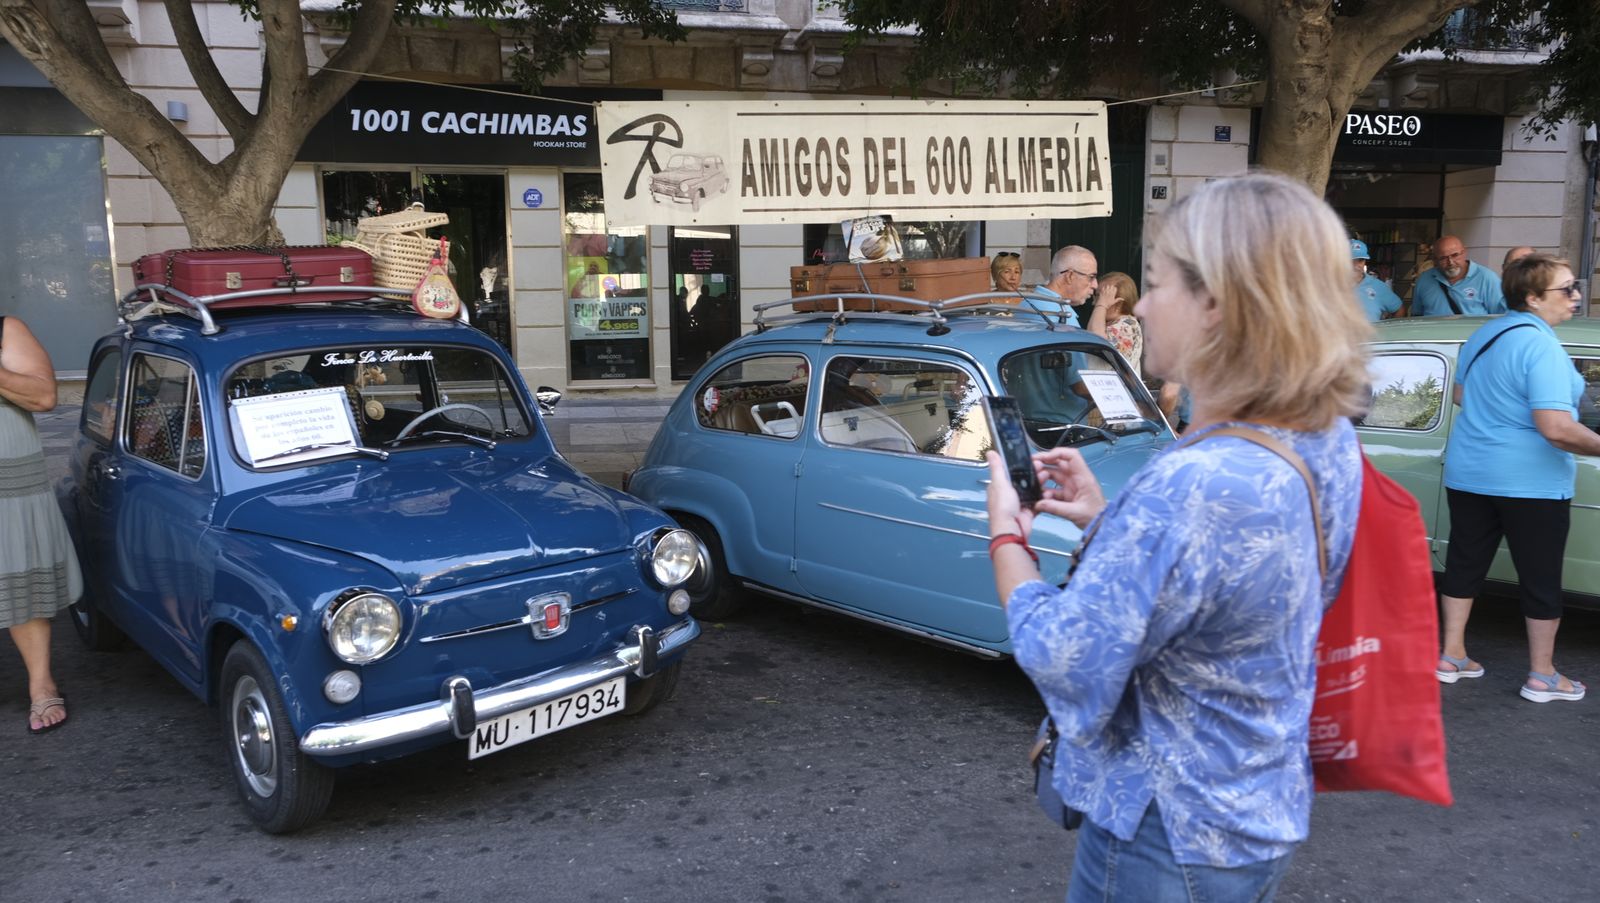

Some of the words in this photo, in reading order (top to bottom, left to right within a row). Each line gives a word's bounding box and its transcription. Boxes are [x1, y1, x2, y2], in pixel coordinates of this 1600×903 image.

[350, 109, 411, 132] 1001
[421, 111, 588, 137] CACHIMBAS
[1345, 113, 1421, 136] PASEO
[533, 140, 565, 148] HOOKAH
[566, 141, 587, 149] STORE
[740, 136, 852, 198] AMIGOS
[863, 136, 916, 196] DEL
[926, 135, 973, 196] 600
[984, 122, 1103, 194] ALMERÍA
[1153, 185, 1167, 199] 79
[357, 350, 377, 364] La
